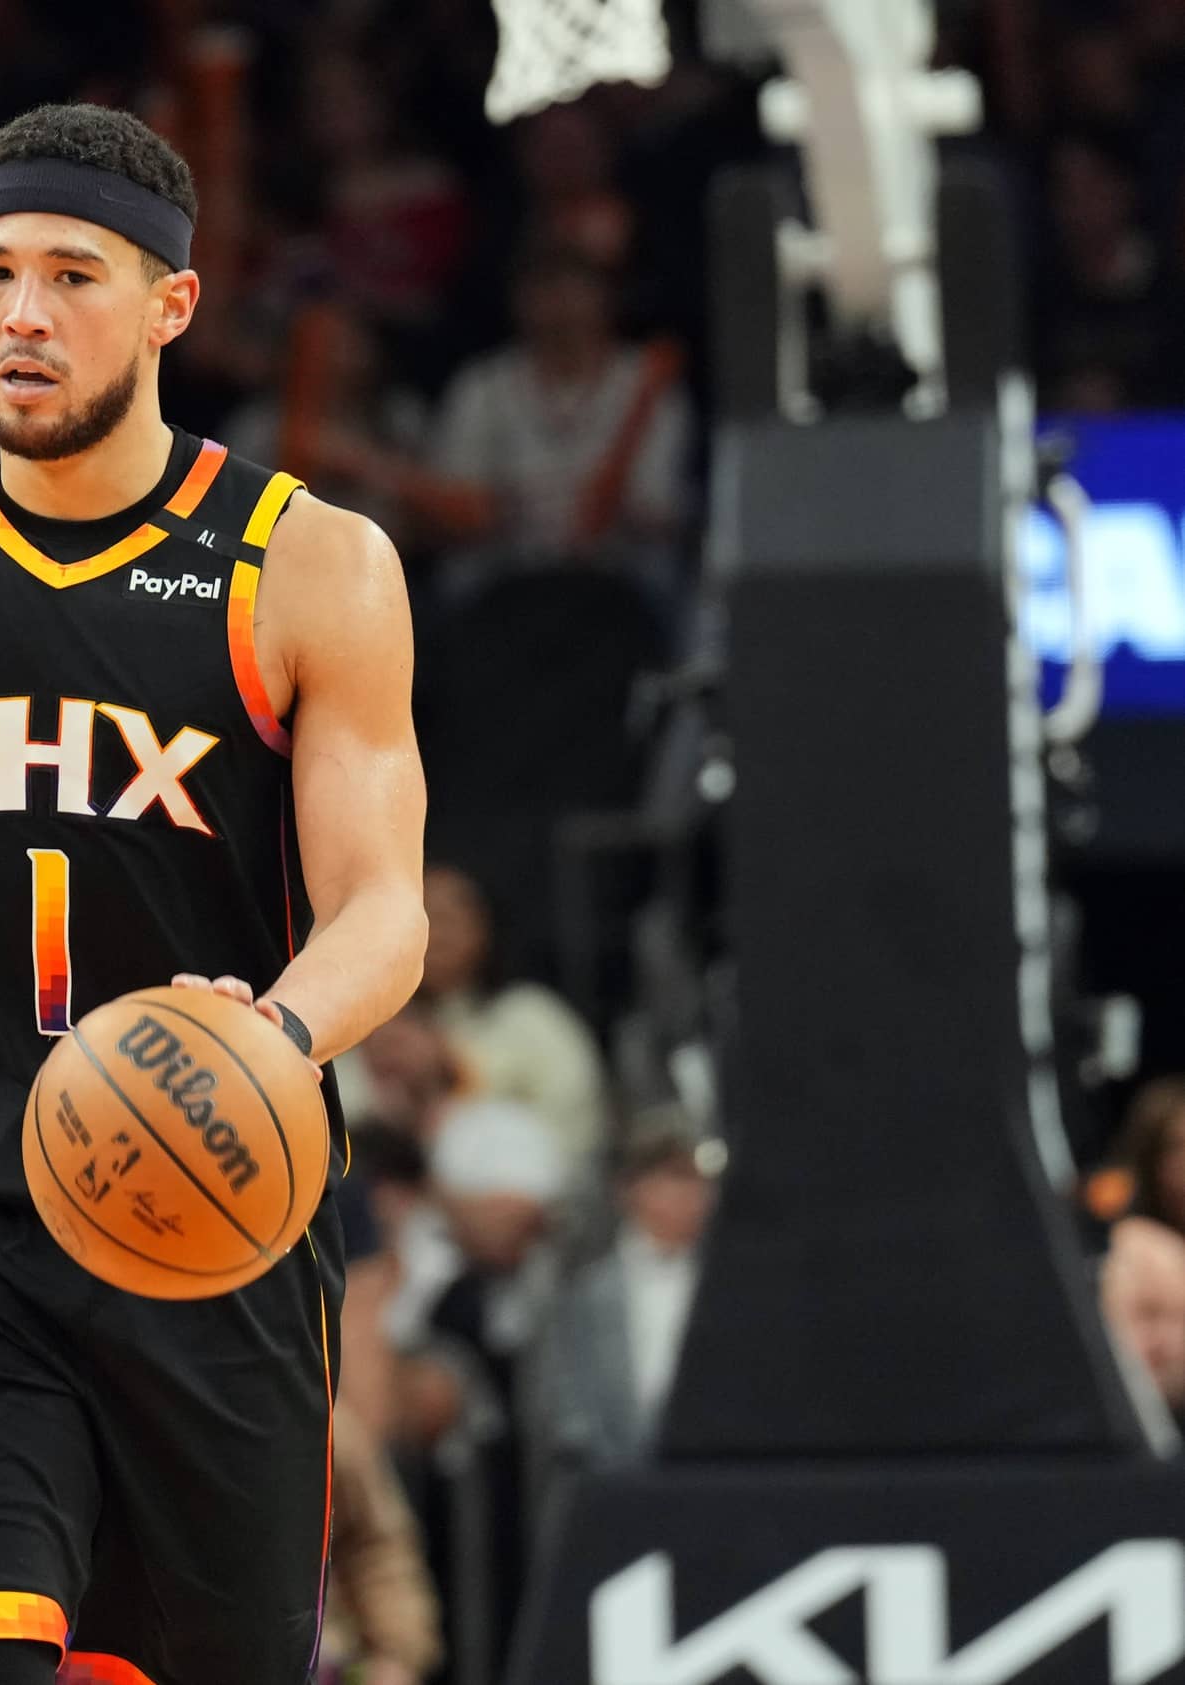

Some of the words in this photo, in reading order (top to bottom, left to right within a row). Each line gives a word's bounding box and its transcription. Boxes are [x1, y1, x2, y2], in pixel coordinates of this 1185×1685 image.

[129, 568, 222, 601] PayPal
[197, 529, 216, 549] AL
[26, 848, 72, 1036] 1
[118, 1013, 260, 1195] Wilson
